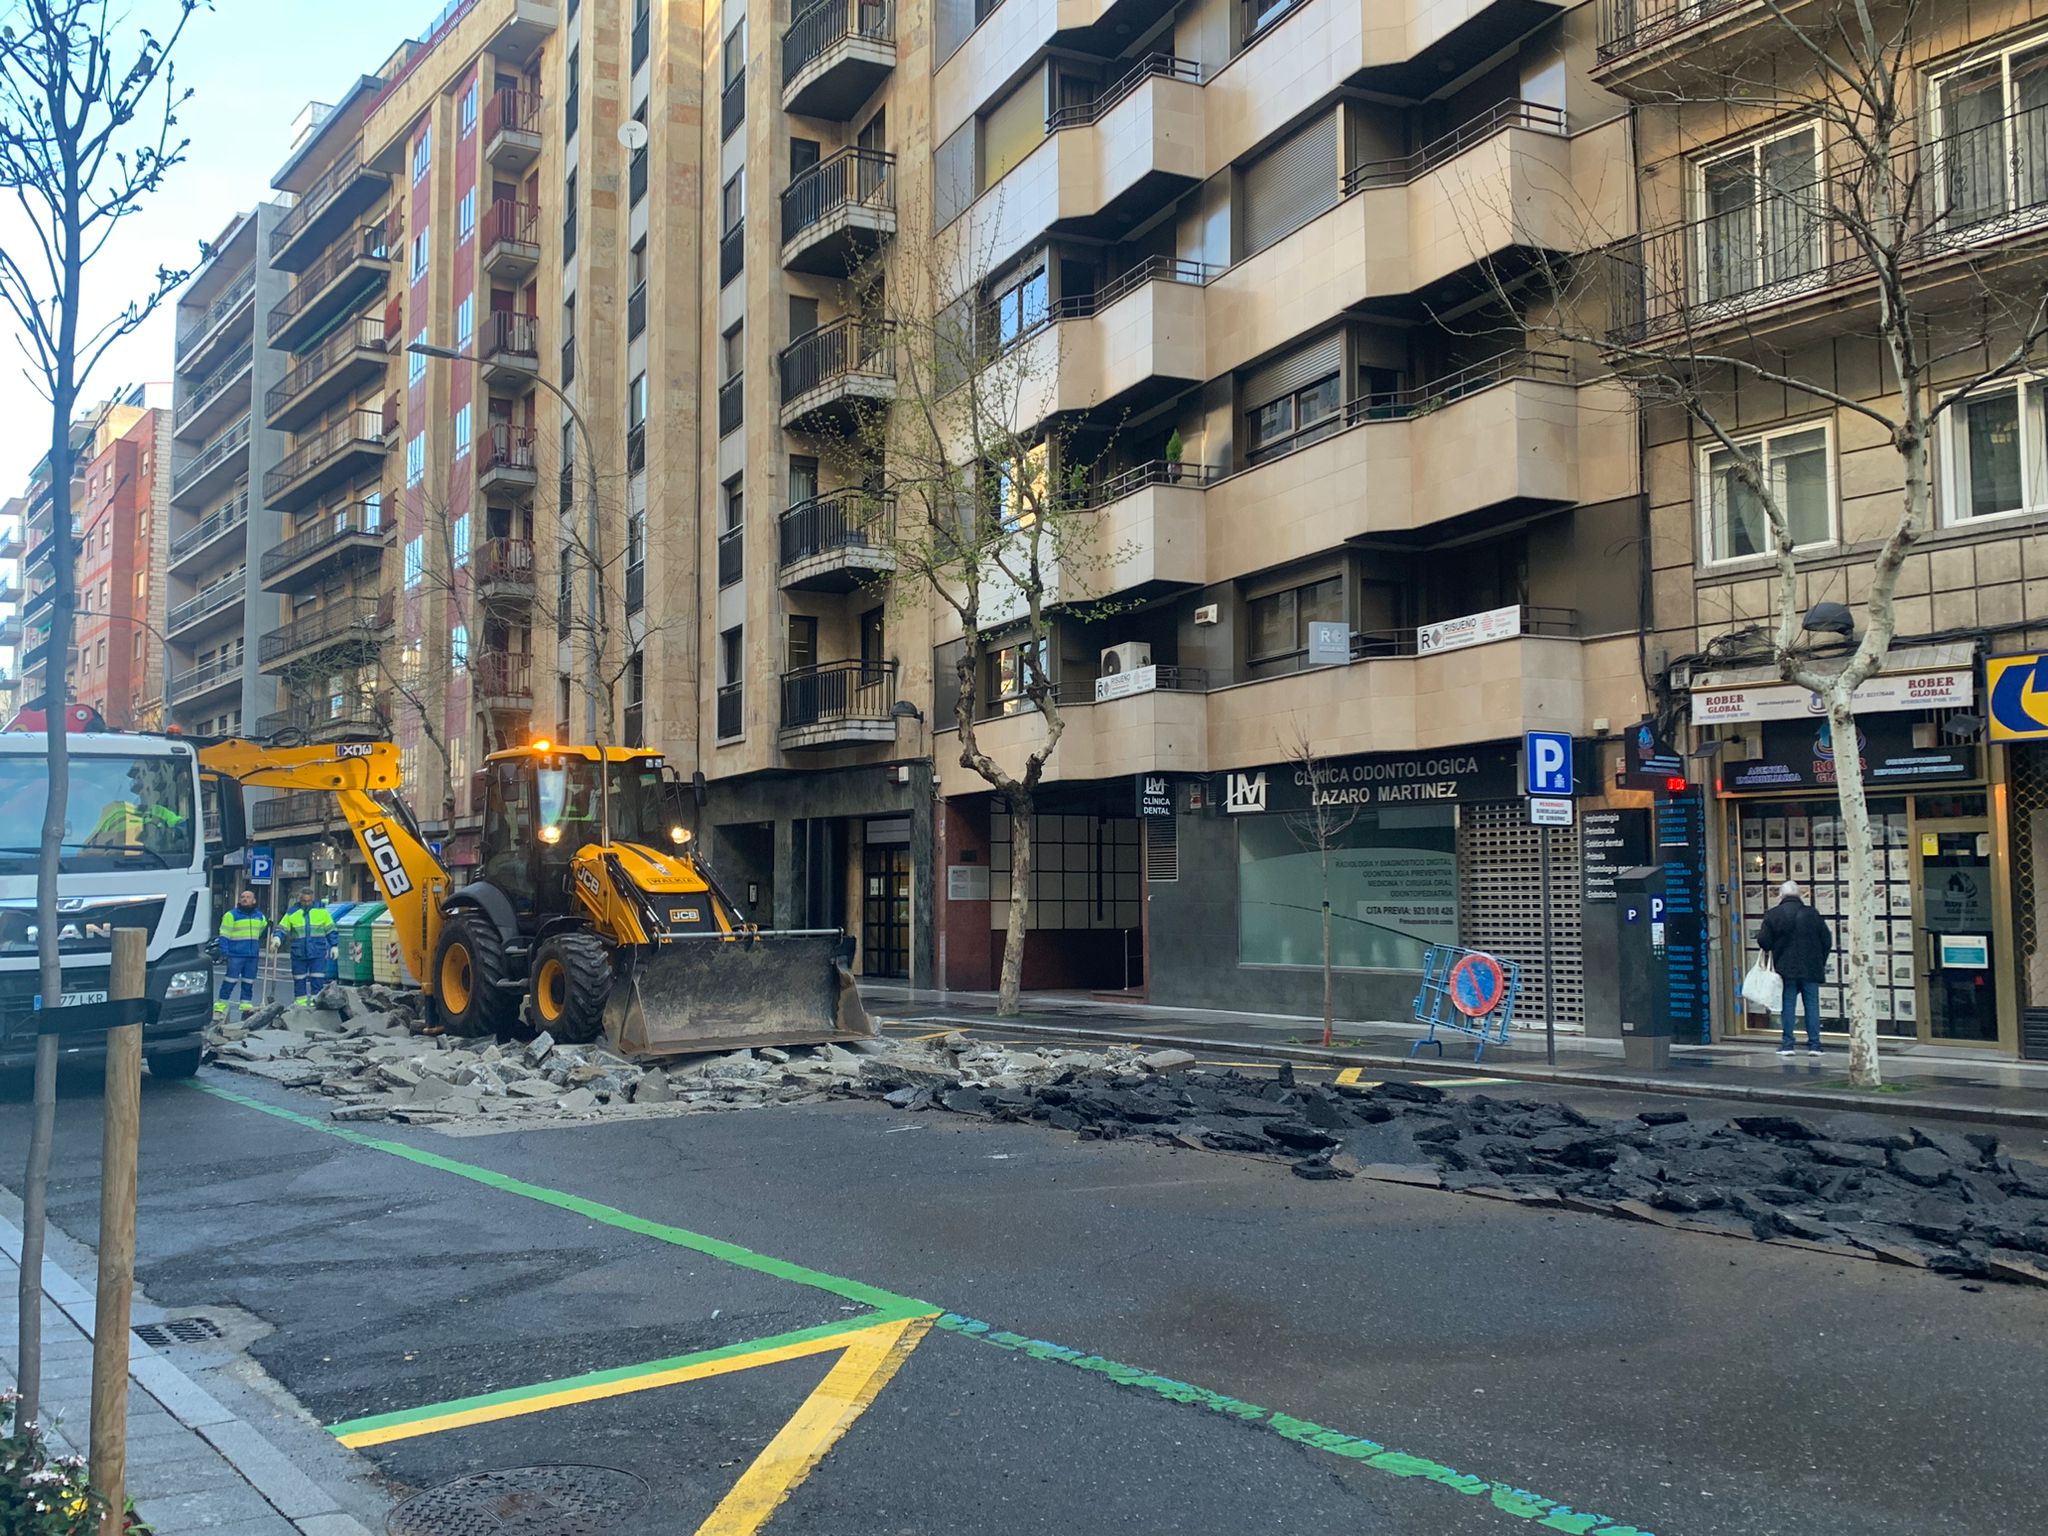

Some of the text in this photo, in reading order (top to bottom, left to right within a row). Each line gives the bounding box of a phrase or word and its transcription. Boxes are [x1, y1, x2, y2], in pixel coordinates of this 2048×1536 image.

[1908, 677, 1955, 689] ROBER
[1910, 688, 1952, 698] GLOBAL
[1706, 694, 1745, 706] ROBER
[1707, 704, 1743, 714] GLOBAL
[1535, 738, 1564, 788] P
[1812, 757, 1868, 774] ROR
[1352, 757, 1479, 782] ODONTOLOGICA
[1312, 781, 1458, 806] LAZARO MARTINEZ
[1143, 796, 1171, 806] CLÍNICA
[1143, 806, 1171, 815] DENTAL
[363, 825, 411, 897] JCB
[254, 859, 269, 876] P
[577, 867, 600, 896] JCB
[1365, 906, 1382, 914] CITA
[1383, 906, 1411, 915] PREVIA:
[1412, 906, 1426, 915] 923
[1628, 909, 1637, 920] P
[1651, 898, 1664, 919] P
[672, 910, 698, 921] JCB
